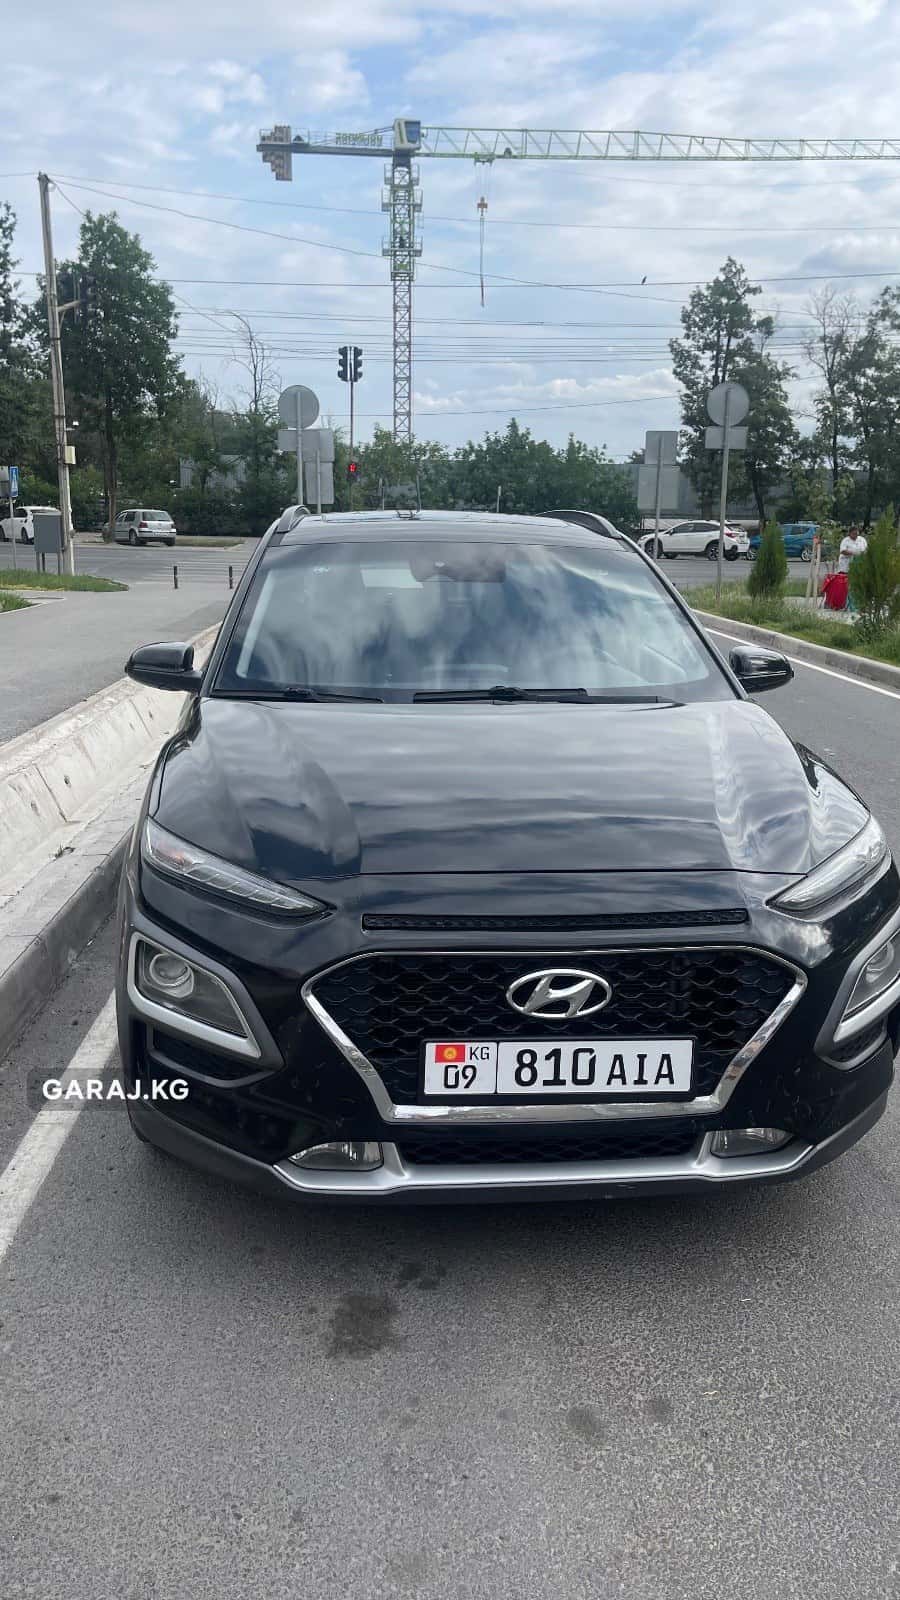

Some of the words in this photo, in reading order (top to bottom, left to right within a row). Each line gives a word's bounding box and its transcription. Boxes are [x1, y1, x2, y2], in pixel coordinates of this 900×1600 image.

[469, 1046, 490, 1061] KG
[443, 1065, 478, 1089] 09
[514, 1048, 597, 1087] 810
[606, 1053, 675, 1086] AIA
